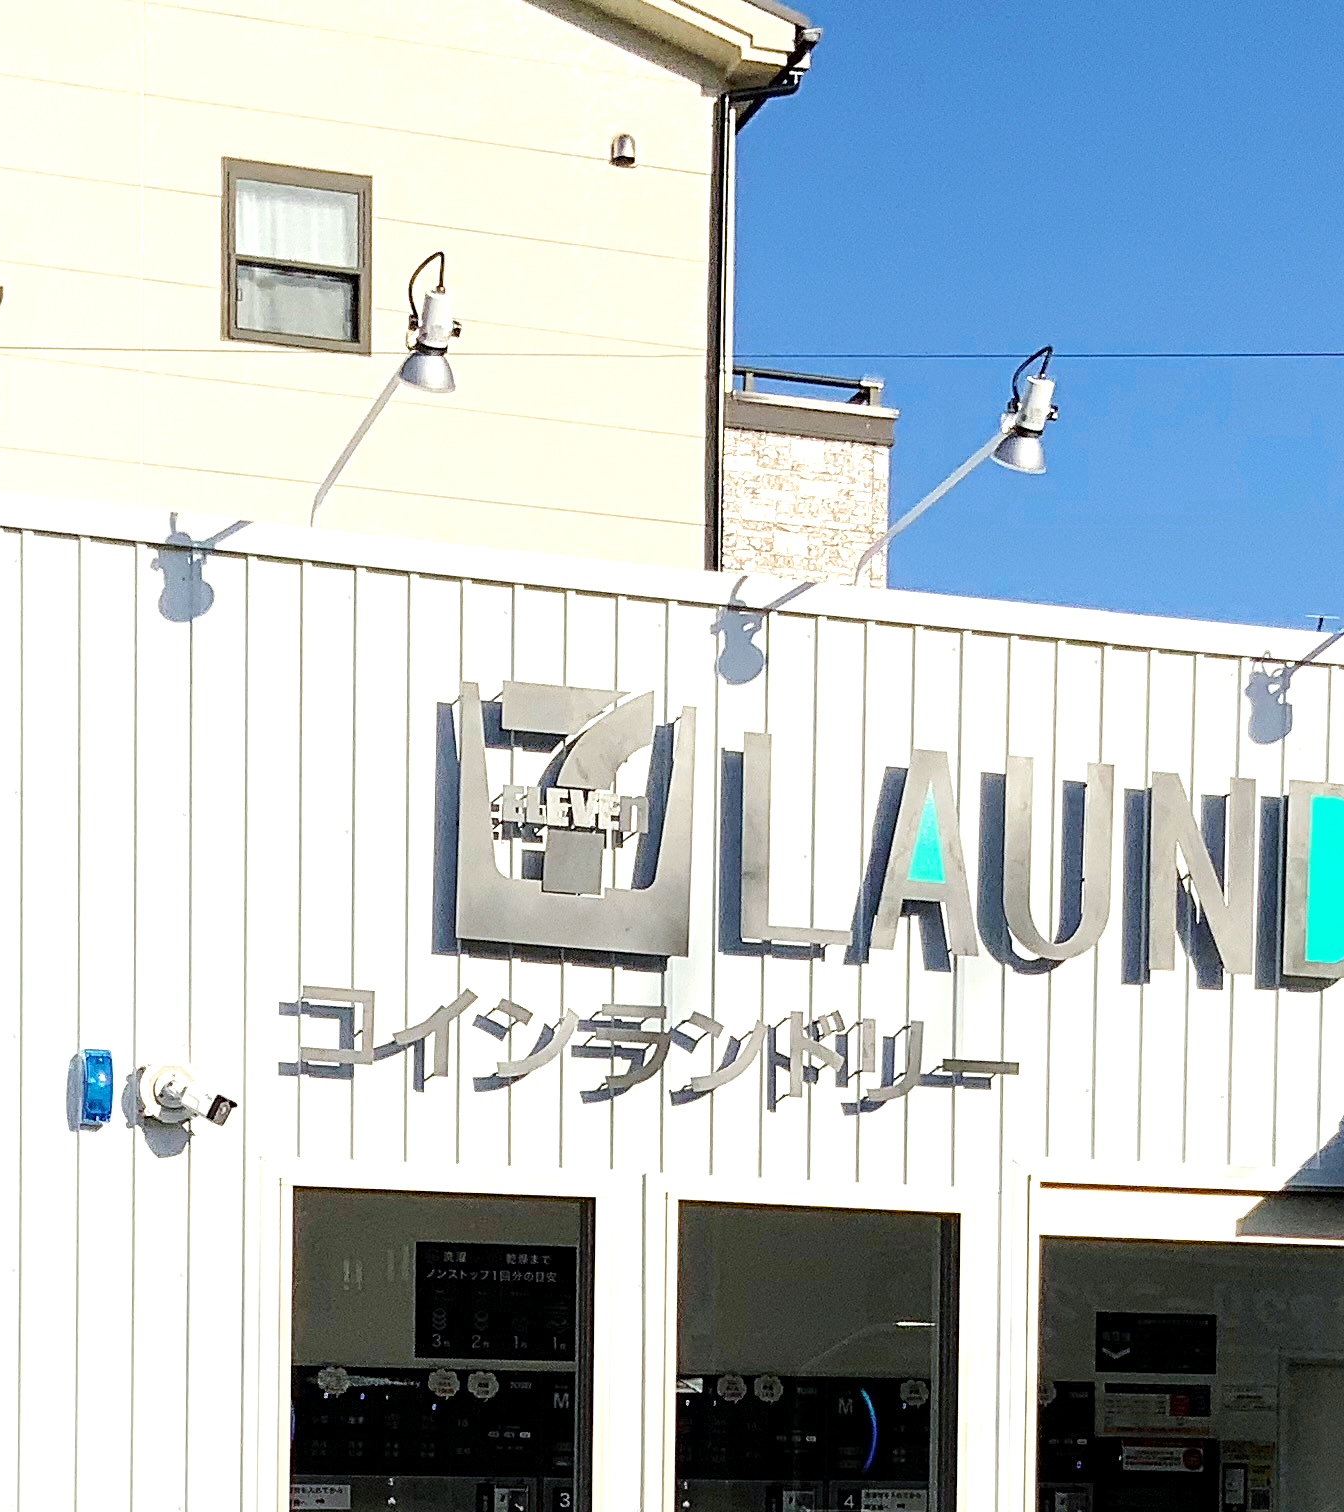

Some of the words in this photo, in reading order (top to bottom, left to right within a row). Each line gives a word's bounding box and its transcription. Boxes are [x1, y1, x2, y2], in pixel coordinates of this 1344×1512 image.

[301, 985, 1020, 1101] コインランドリー
[553, 1391, 570, 1410] M
[837, 1397, 854, 1416] M
[559, 1492, 571, 1509] 3
[842, 1494, 855, 1510] 4
